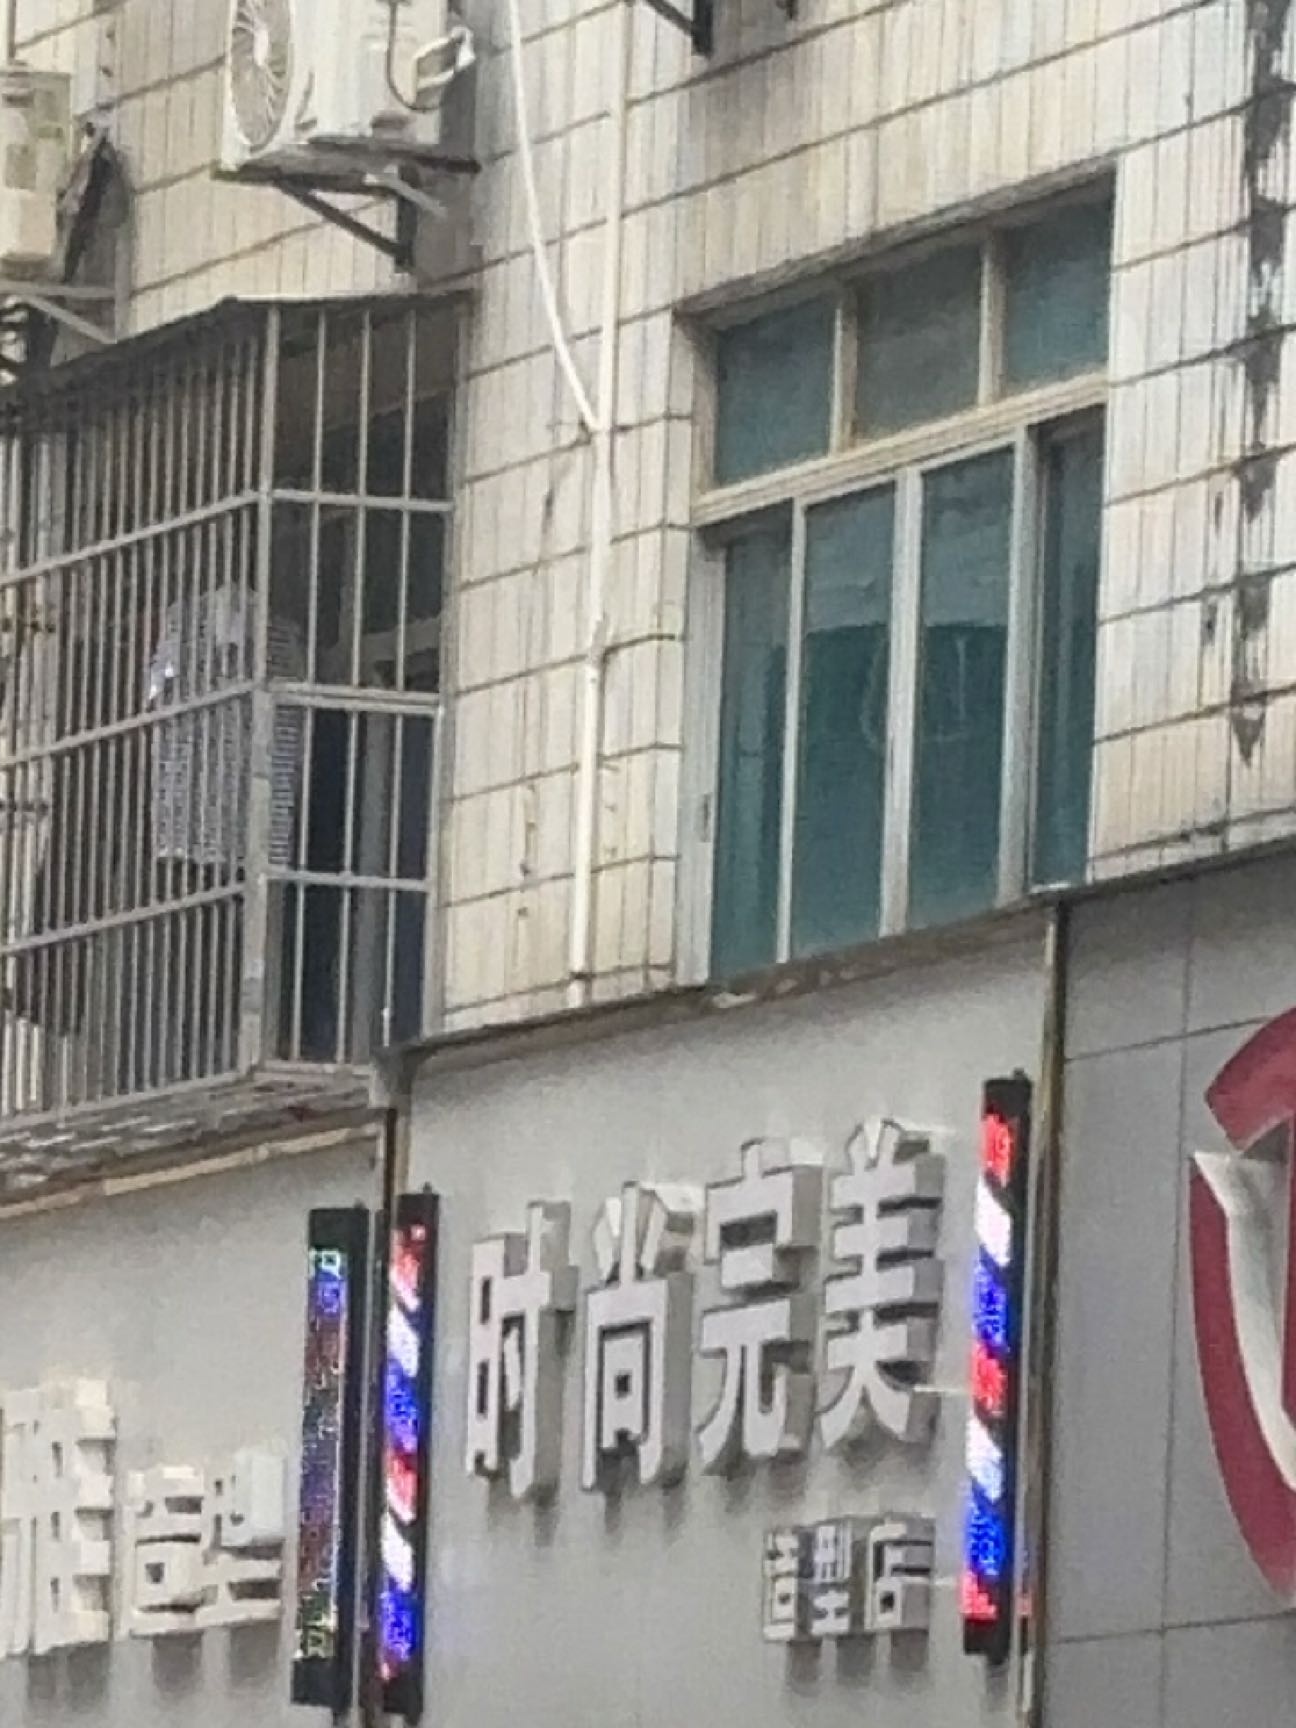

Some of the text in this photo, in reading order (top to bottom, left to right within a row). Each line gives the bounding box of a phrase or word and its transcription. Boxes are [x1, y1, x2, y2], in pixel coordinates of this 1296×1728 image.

[465, 1118, 944, 1499] 时尚完美
[762, 1517, 935, 1642] 造型店
